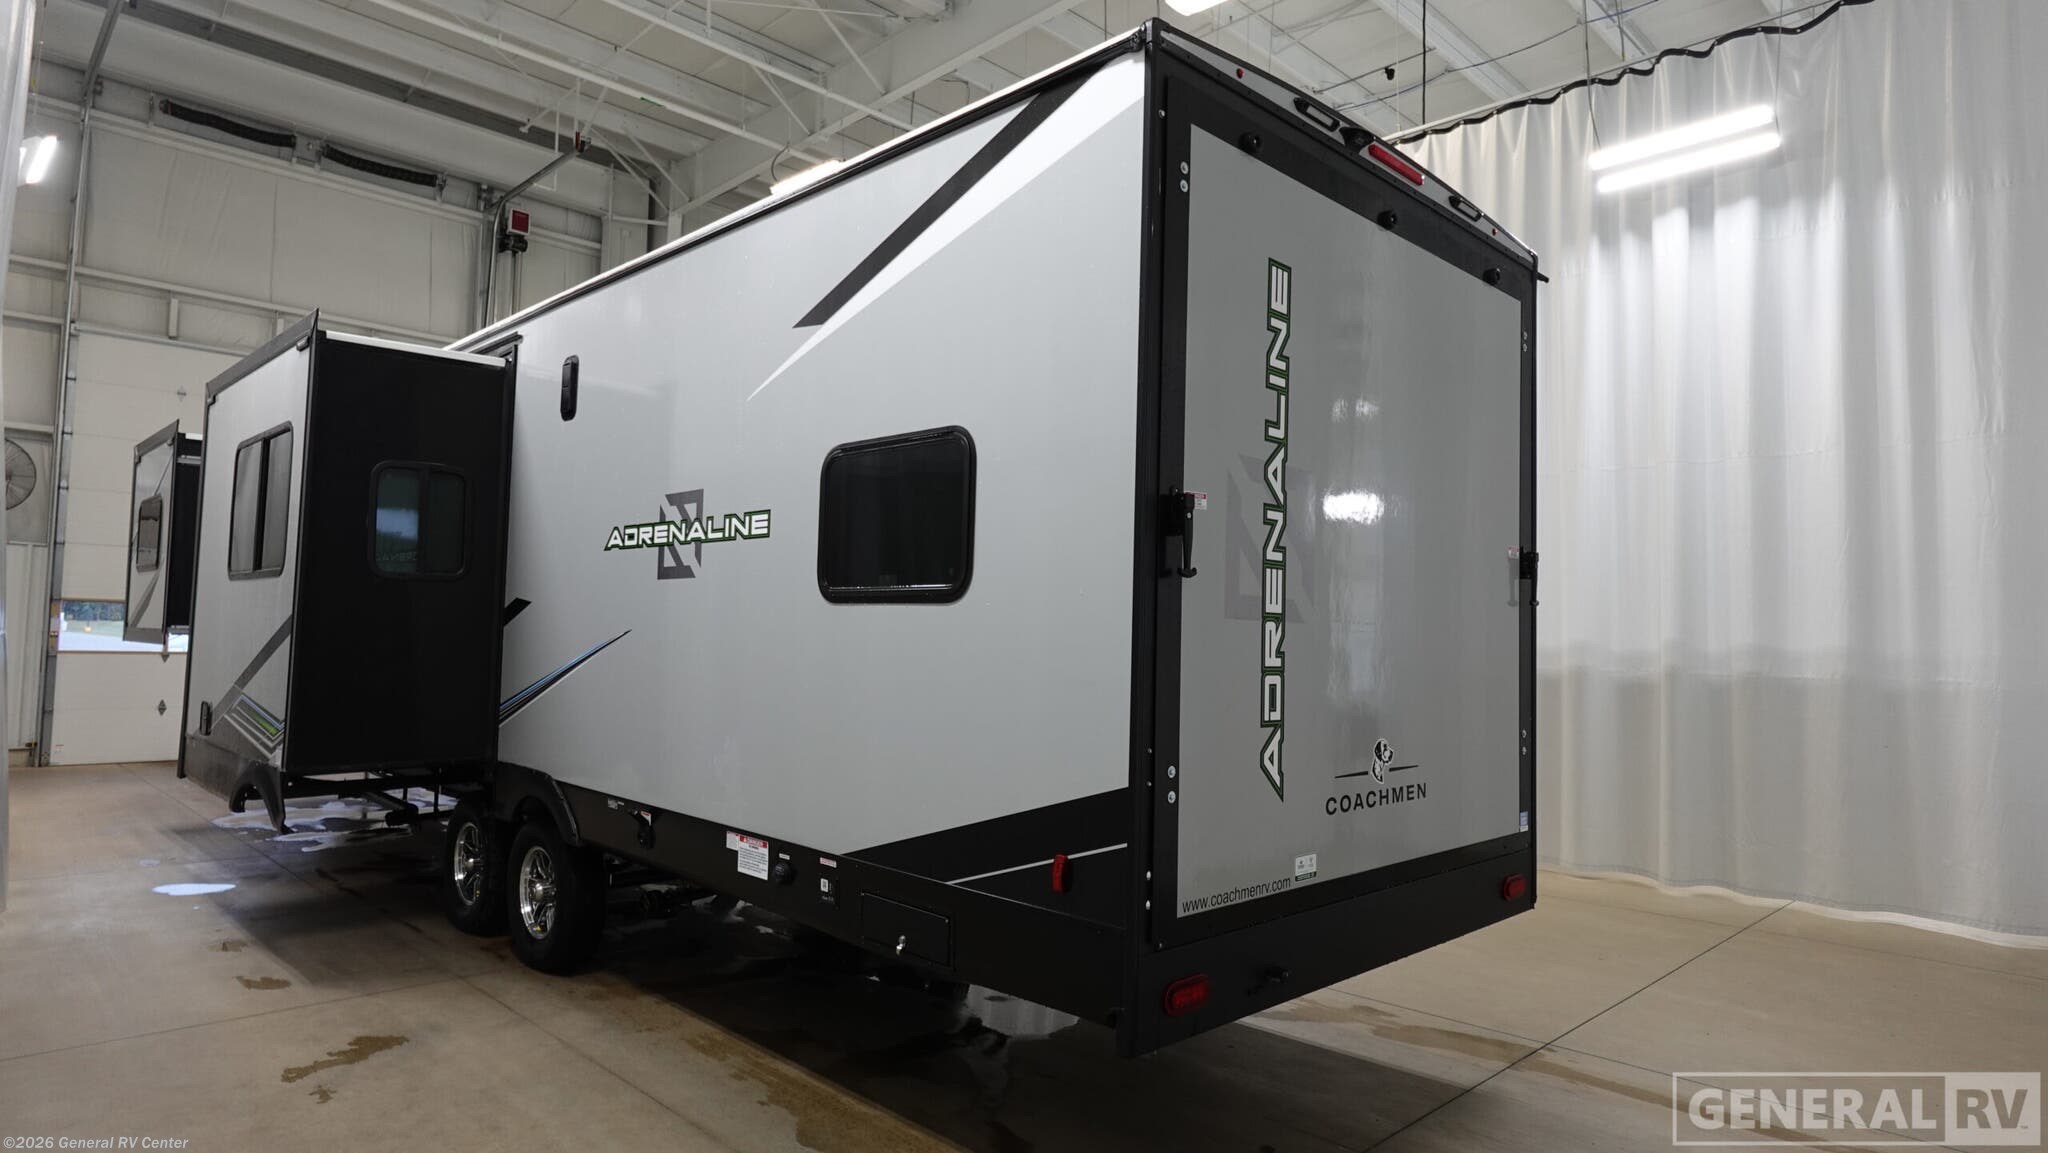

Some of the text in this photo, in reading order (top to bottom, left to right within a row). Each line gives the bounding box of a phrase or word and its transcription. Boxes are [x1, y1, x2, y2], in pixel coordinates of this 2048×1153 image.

[604, 509, 771, 551] ADRENALINE
[1260, 257, 1292, 802] ADRENALINE
[1325, 782, 1428, 816] COACHMEN
[1182, 877, 1292, 913] www.coachmenrv.com
